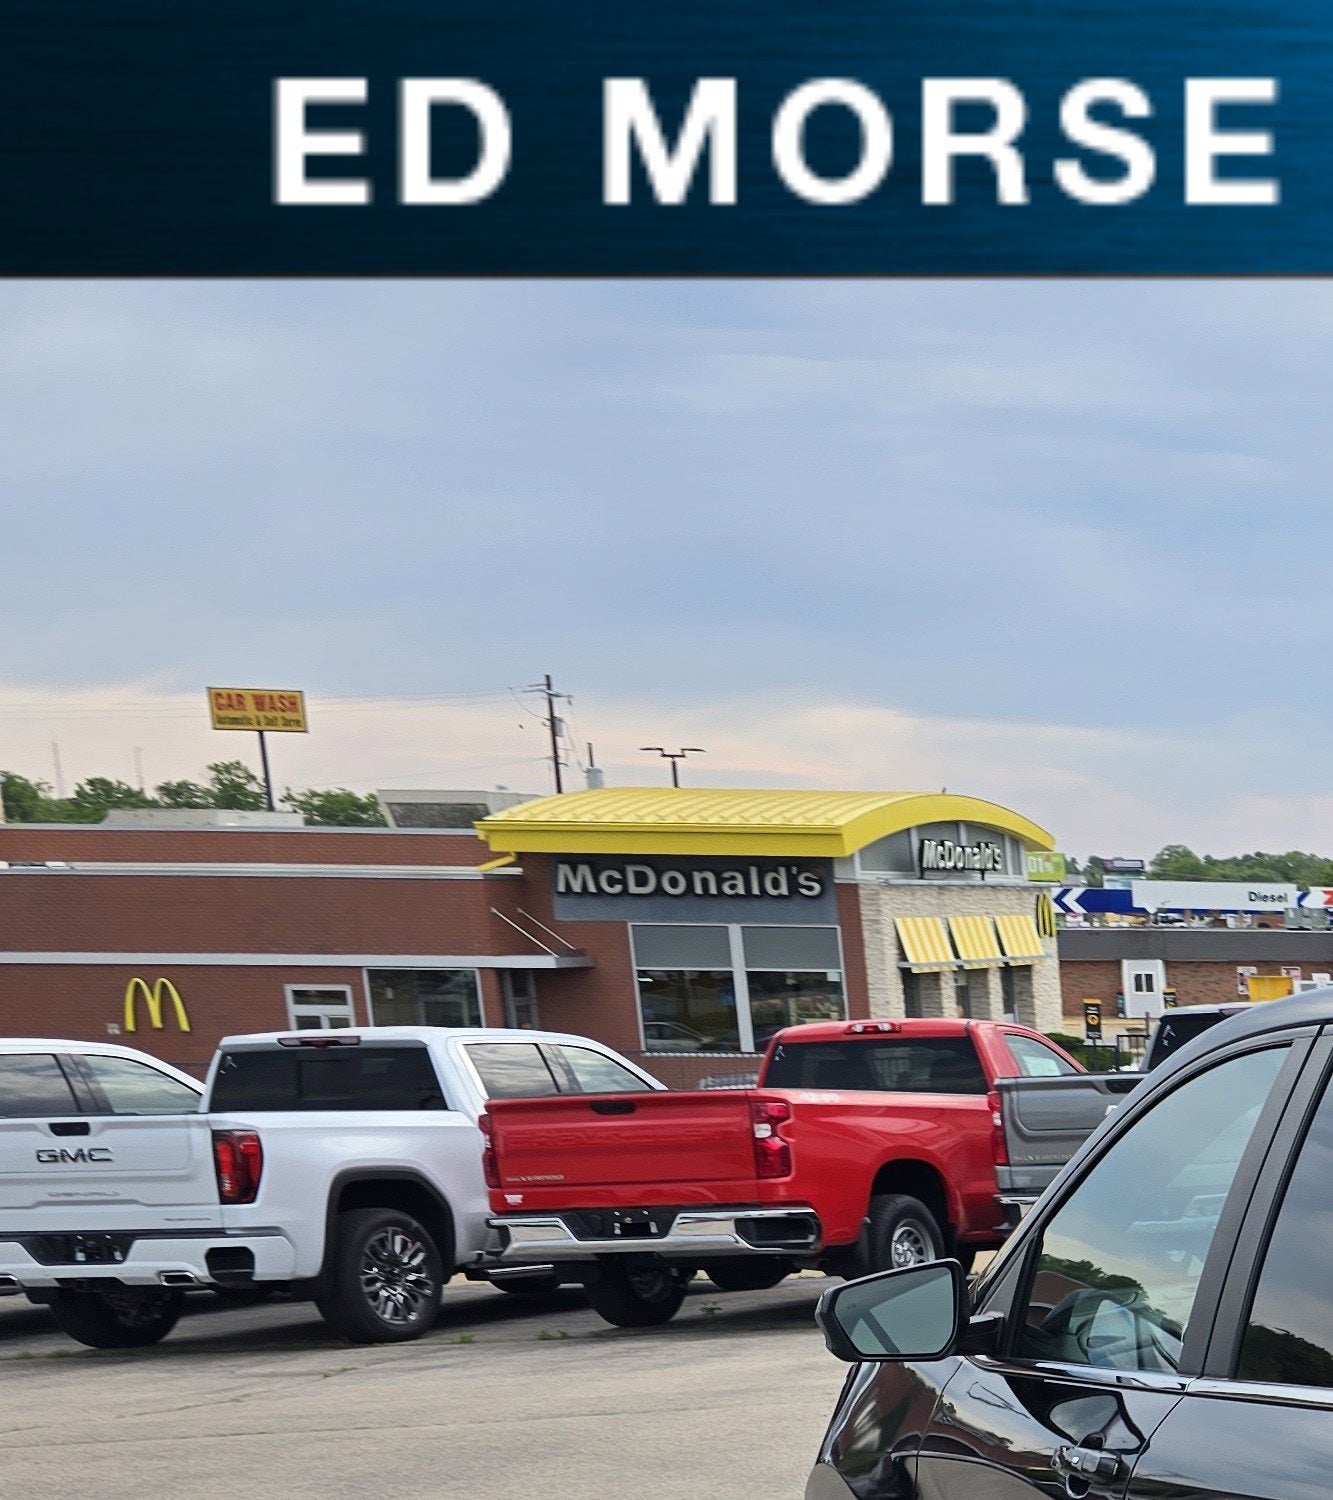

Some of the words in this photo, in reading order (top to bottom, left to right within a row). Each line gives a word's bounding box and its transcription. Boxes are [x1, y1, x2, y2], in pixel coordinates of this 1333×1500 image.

[214, 692, 247, 711] CAR
[252, 693, 299, 713] WASH
[922, 839, 1002, 871] McDonald's
[556, 863, 823, 897] McDonald's
[1248, 891, 1289, 903] Diesel
[36, 1148, 114, 1164] GMC
